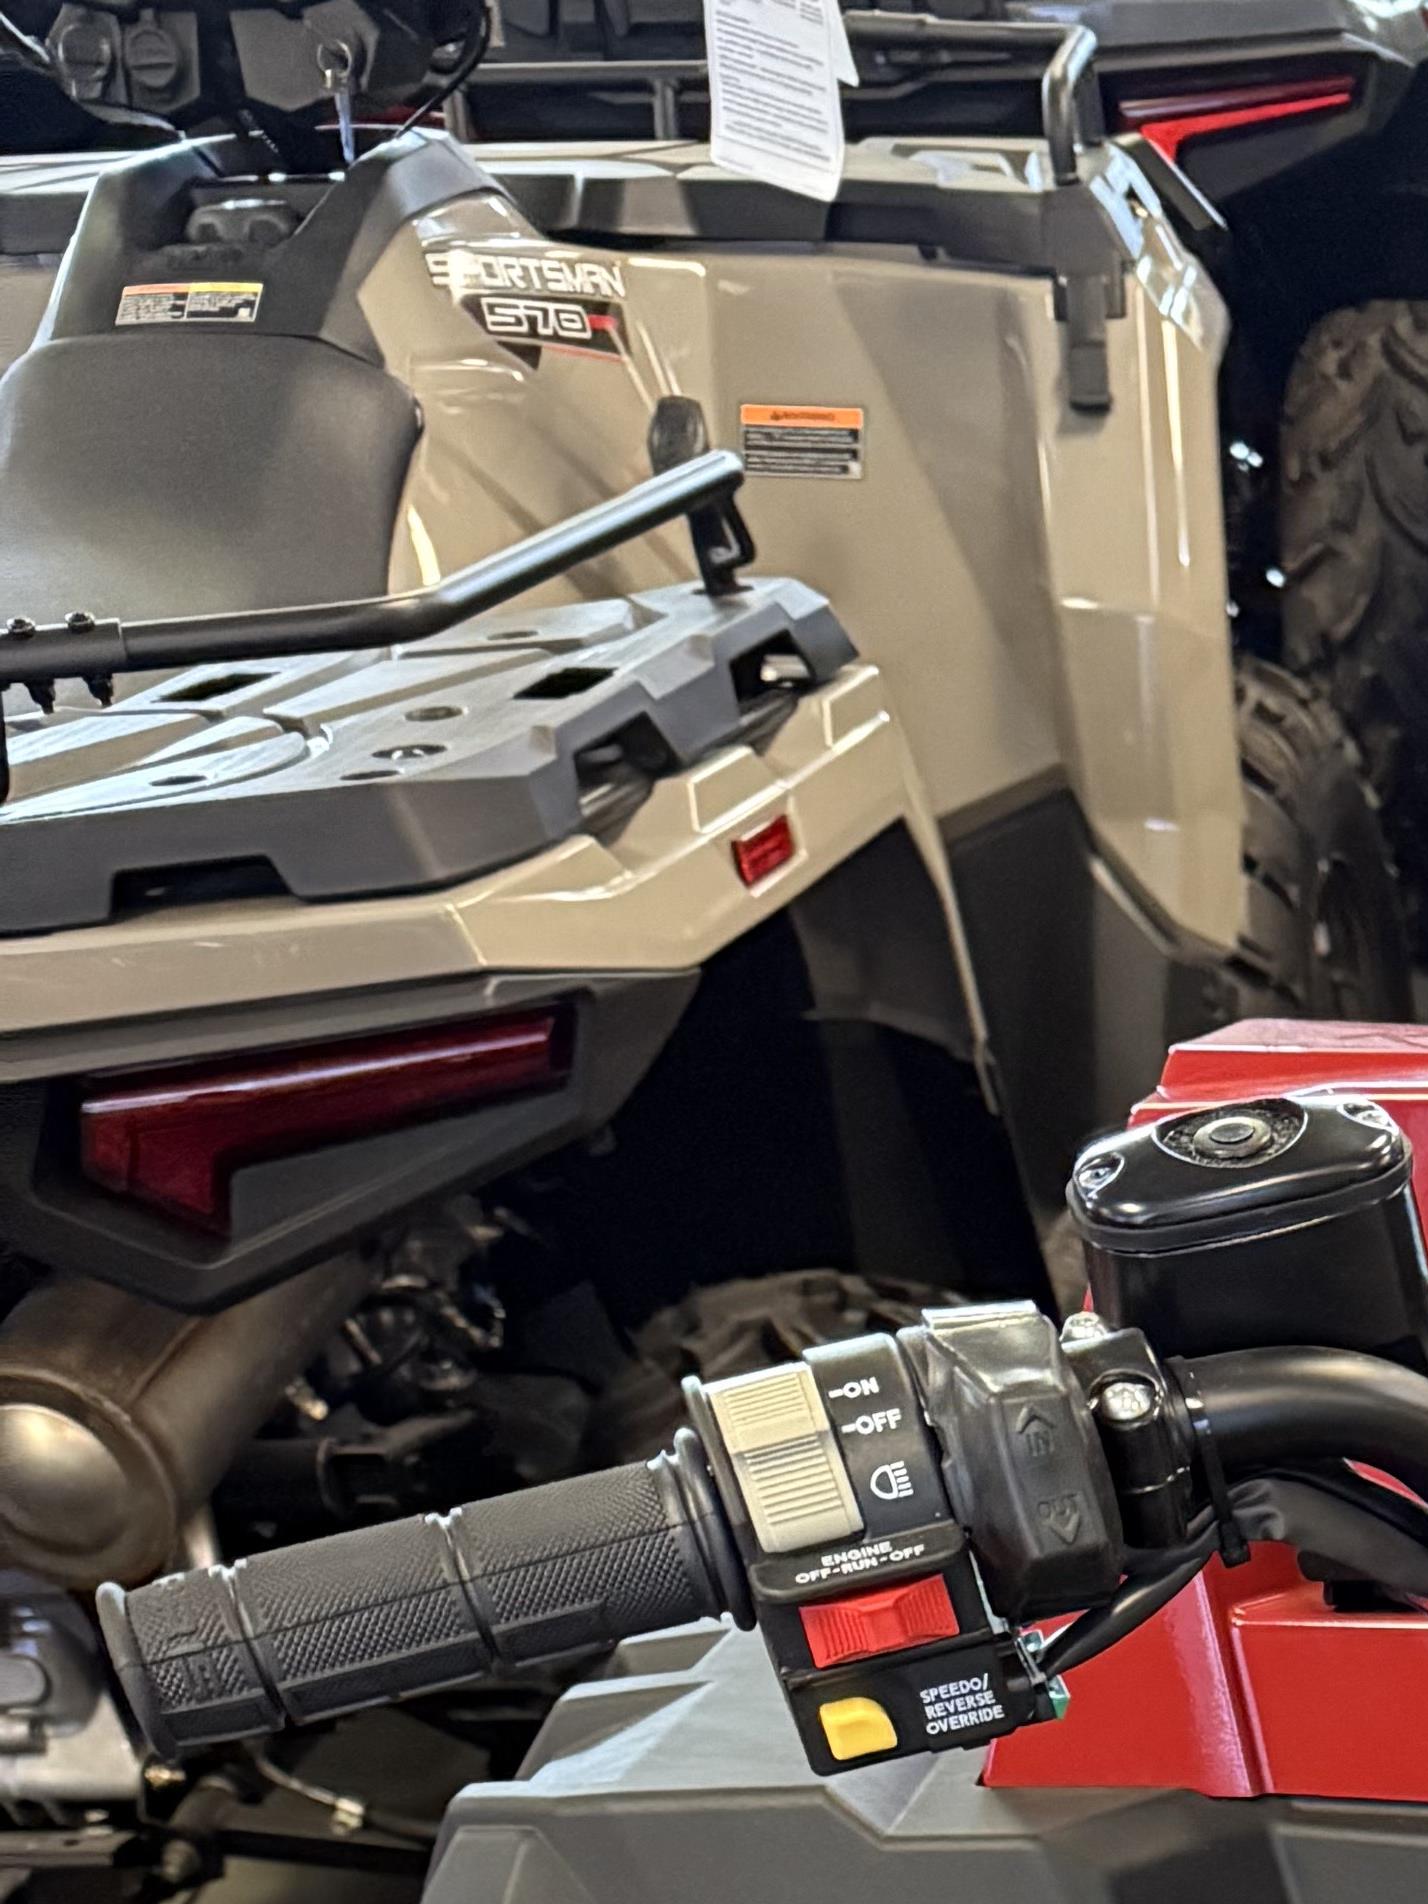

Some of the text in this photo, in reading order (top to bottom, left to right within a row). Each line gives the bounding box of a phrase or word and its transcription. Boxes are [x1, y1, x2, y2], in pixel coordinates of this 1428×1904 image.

[425, 253, 626, 297] SORTSMAN
[481, 297, 592, 339] 570
[821, 1541, 893, 1567] ENGINE
[919, 1673, 989, 1704] SPEEDO/
[925, 1690, 996, 1721] REVERSE
[926, 1705, 1005, 1735] OVERRIDE
